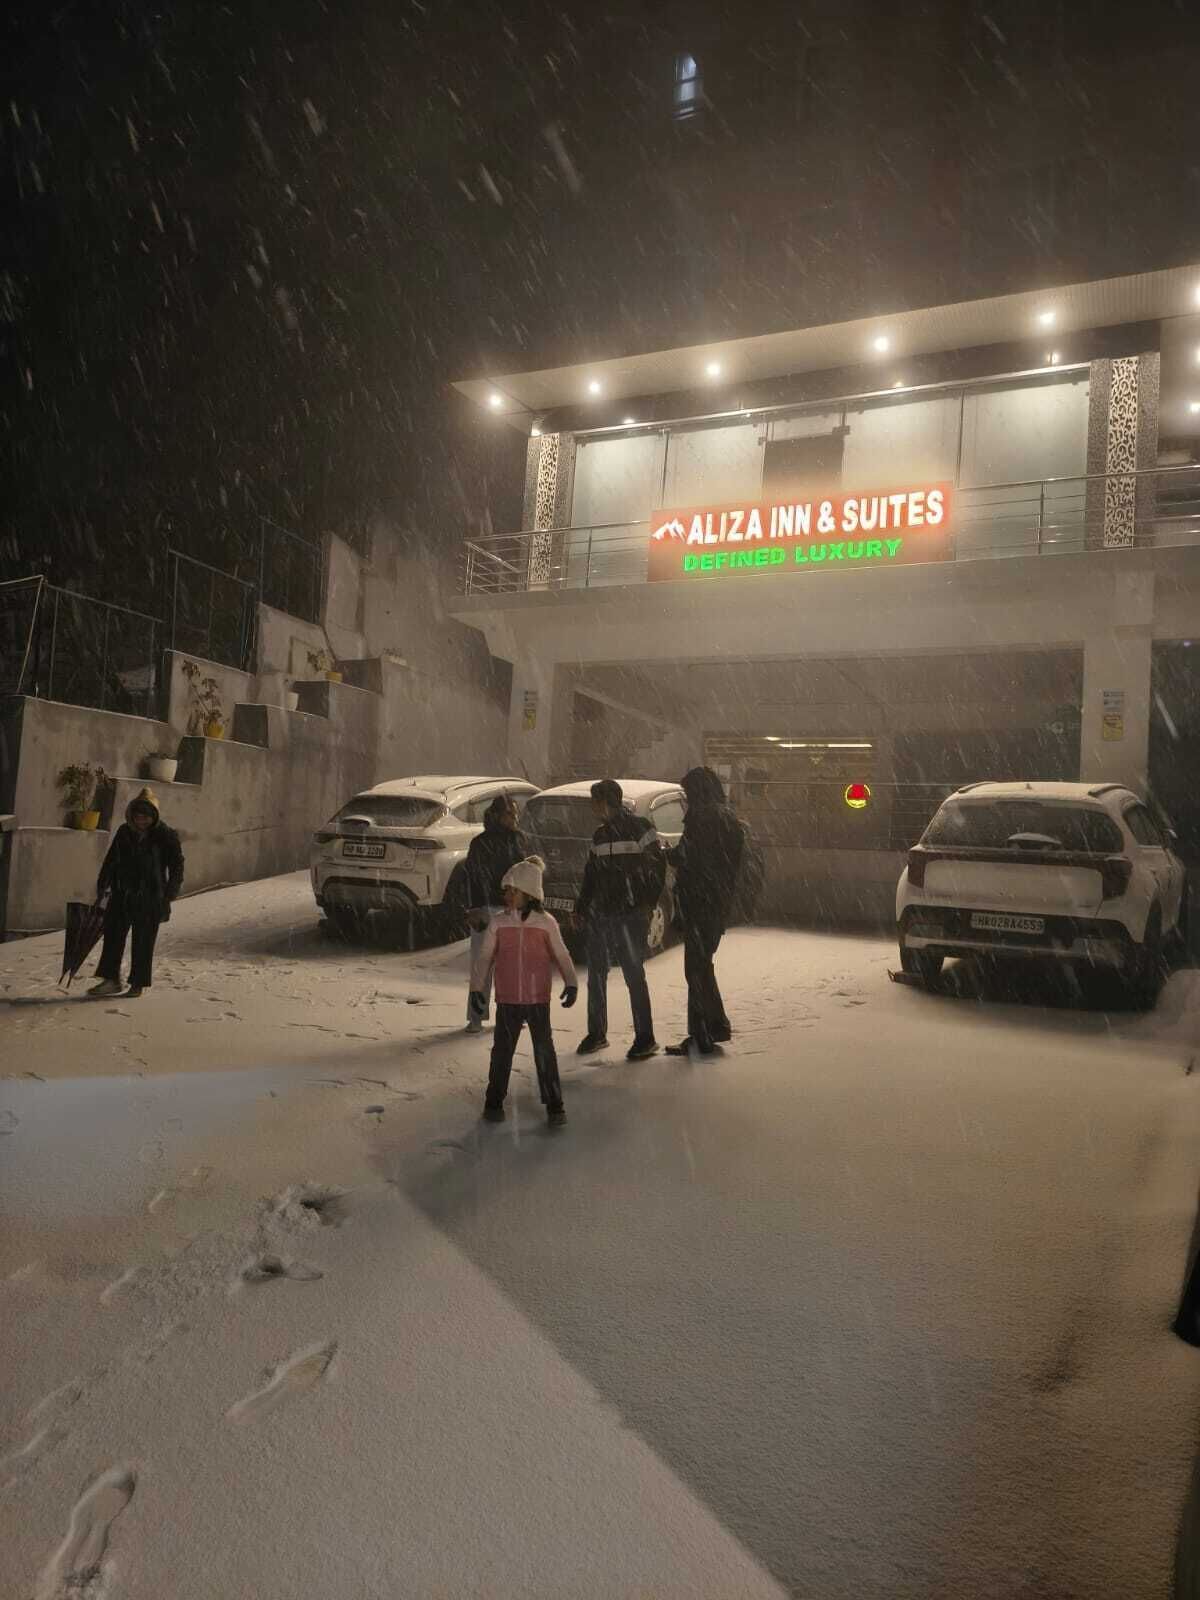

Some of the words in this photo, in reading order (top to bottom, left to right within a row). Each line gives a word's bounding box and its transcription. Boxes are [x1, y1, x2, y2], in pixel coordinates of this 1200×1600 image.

[687, 508, 763, 545] ALIZA
[770, 503, 812, 537] INN
[817, 501, 836, 534] &
[842, 490, 944, 531] SUITES
[684, 547, 786, 571] DEFINED
[795, 539, 903, 564] LUXURY
